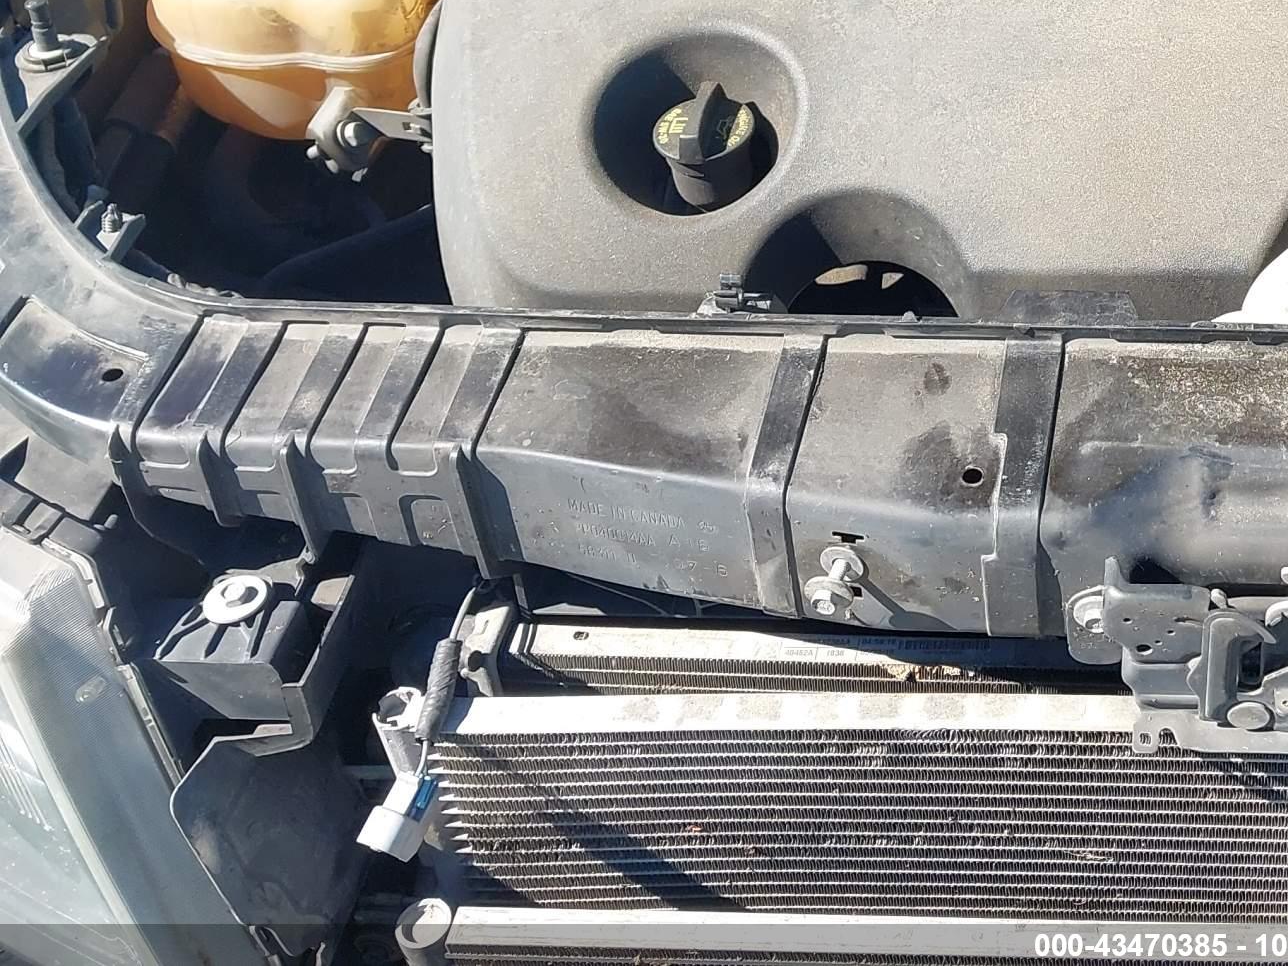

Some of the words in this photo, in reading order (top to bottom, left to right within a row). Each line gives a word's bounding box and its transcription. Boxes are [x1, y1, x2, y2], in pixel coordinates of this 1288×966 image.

[567, 497, 604, 516] MADE
[610, 505, 626, 521] IN
[630, 509, 687, 530] CANADA
